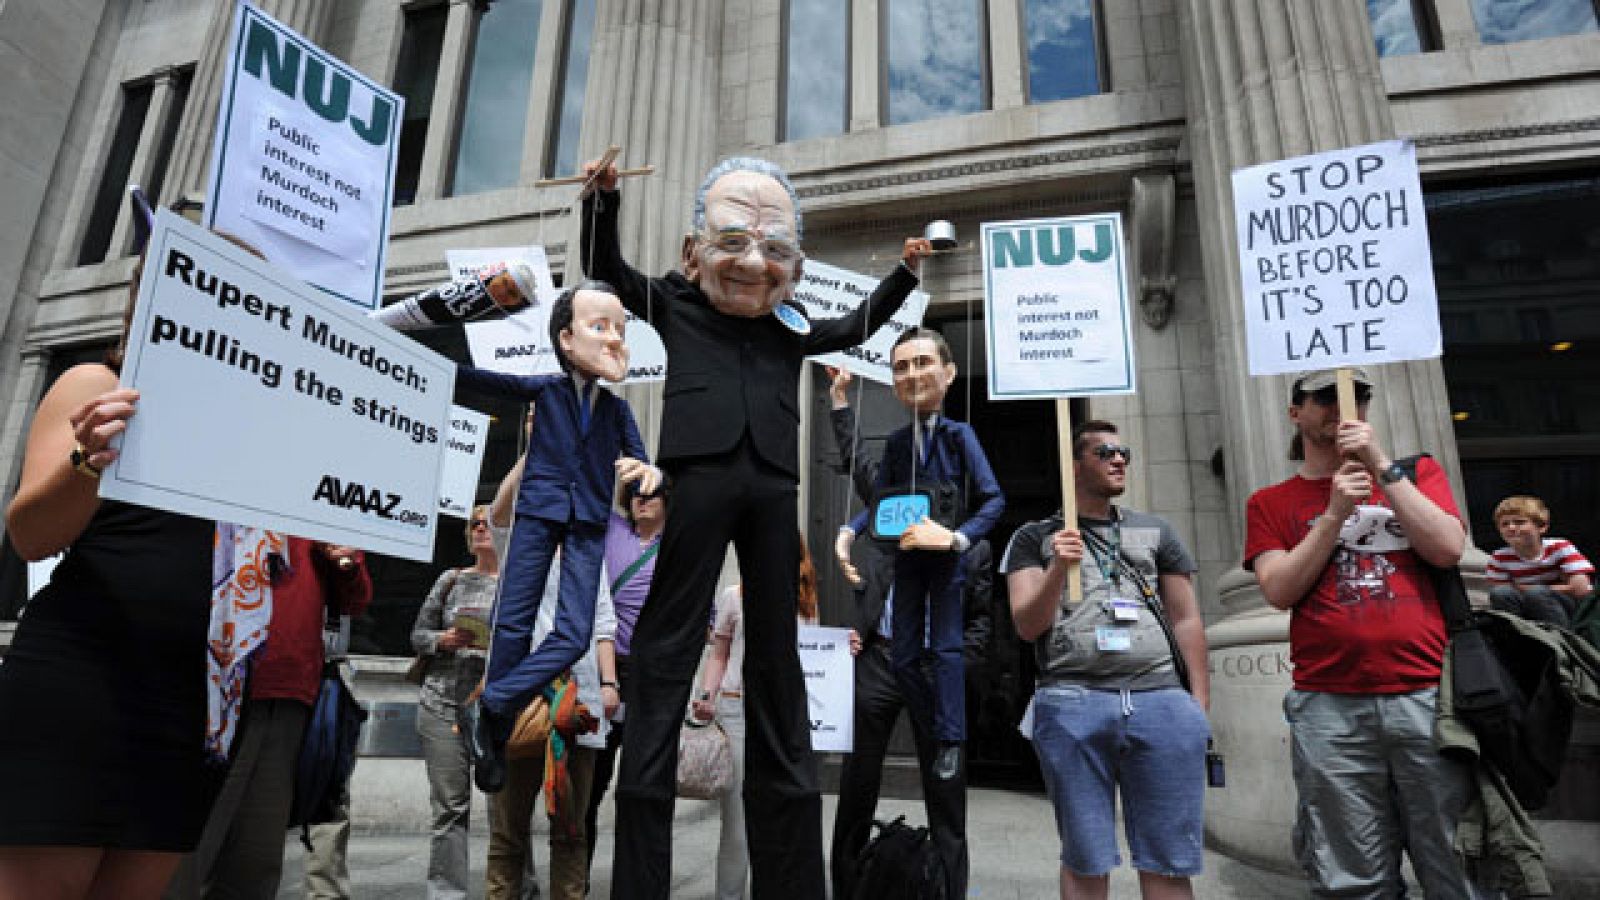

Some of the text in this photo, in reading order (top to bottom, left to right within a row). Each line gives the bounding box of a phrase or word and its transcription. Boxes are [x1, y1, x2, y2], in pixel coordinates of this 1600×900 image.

[244, 17, 391, 146] NUJ
[268, 117, 320, 156] Public
[260, 165, 339, 213] Murdoch
[264, 140, 361, 200] interest not
[1266, 155, 1385, 199] STOP
[256, 190, 325, 231] interest
[1247, 189, 1409, 251] MURDOCH
[991, 224, 1114, 269] NUJ
[1257, 240, 1382, 284] BEFORE
[1016, 292, 1060, 306] Public
[1016, 309, 1101, 324] interest not
[1262, 274, 1409, 321] IT'S TOO
[165, 248, 429, 394] Rupert Murdoch:
[1018, 328, 1083, 342] Murdoch
[1284, 317, 1386, 361] LATE
[1019, 347, 1074, 361] interest
[149, 315, 440, 445] pulling the strings
